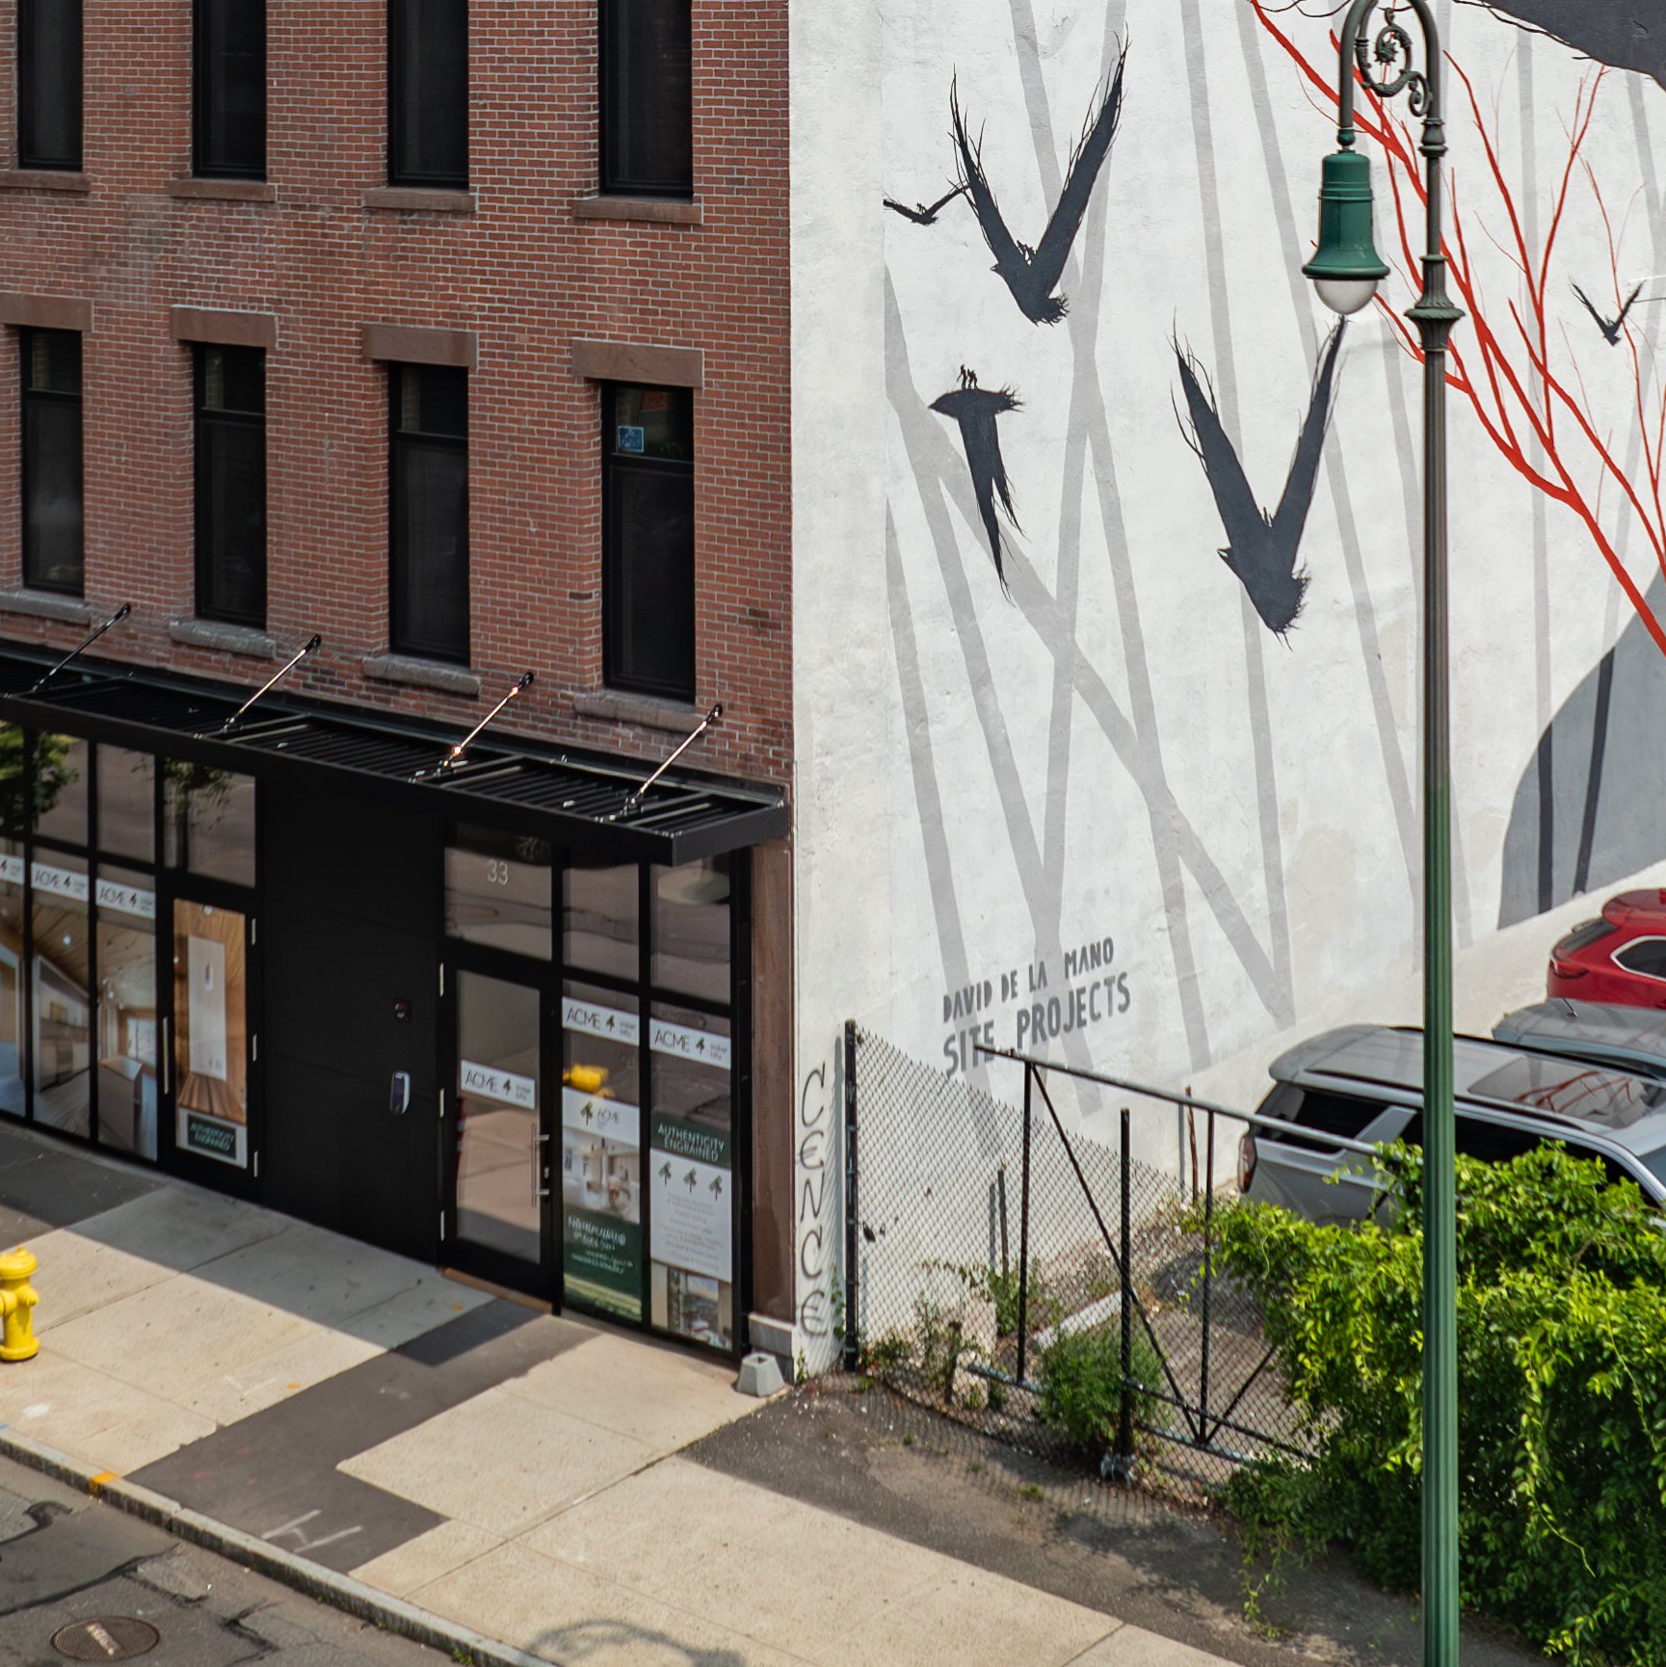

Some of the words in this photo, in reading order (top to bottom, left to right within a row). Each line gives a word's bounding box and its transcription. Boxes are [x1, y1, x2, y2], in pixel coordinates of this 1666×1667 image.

[486, 858, 509, 886] 33
[943, 980, 993, 1024] DAVID
[1001, 970, 1019, 1001] DE
[1028, 960, 1048, 993] LA
[1064, 936, 1114, 978] MANO
[566, 1005, 601, 1031] ACME
[944, 1020, 995, 1077] SITE
[1016, 972, 1131, 1049] PROJECTS
[654, 1028, 691, 1054] ACME
[657, 1122, 726, 1152] AUTHENTICITY
[663, 1138, 720, 1163] ENGRAINED
